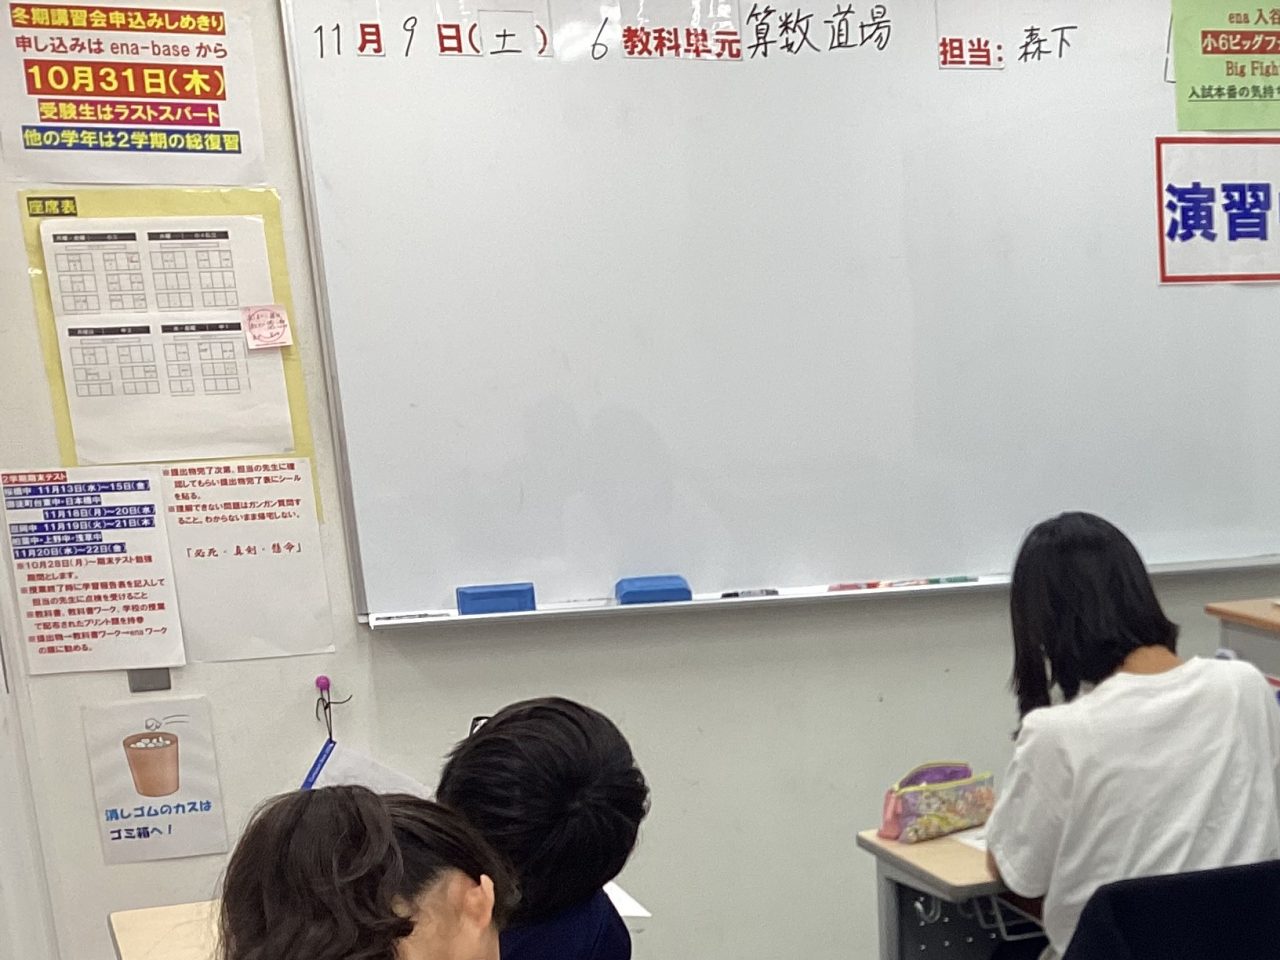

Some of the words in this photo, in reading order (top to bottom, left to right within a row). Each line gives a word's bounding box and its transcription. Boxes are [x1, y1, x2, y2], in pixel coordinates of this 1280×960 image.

[11, 6, 224, 33] 冬期講習会申込みしめきり
[1228, 12, 1250, 25] ena
[622, 26, 742, 58] 教科単元
[746, 4, 892, 59] 算数道場
[15, 36, 104, 54] 申し込みは
[110, 40, 190, 57] ena-base
[196, 42, 228, 59] から
[1226, 61, 1246, 77] Big
[27, 64, 226, 97] 10月31日(木)
[23, 129, 239, 151] 他の学年は2学期の総復習
[105, 800, 212, 821] 消しゴムのカスは
